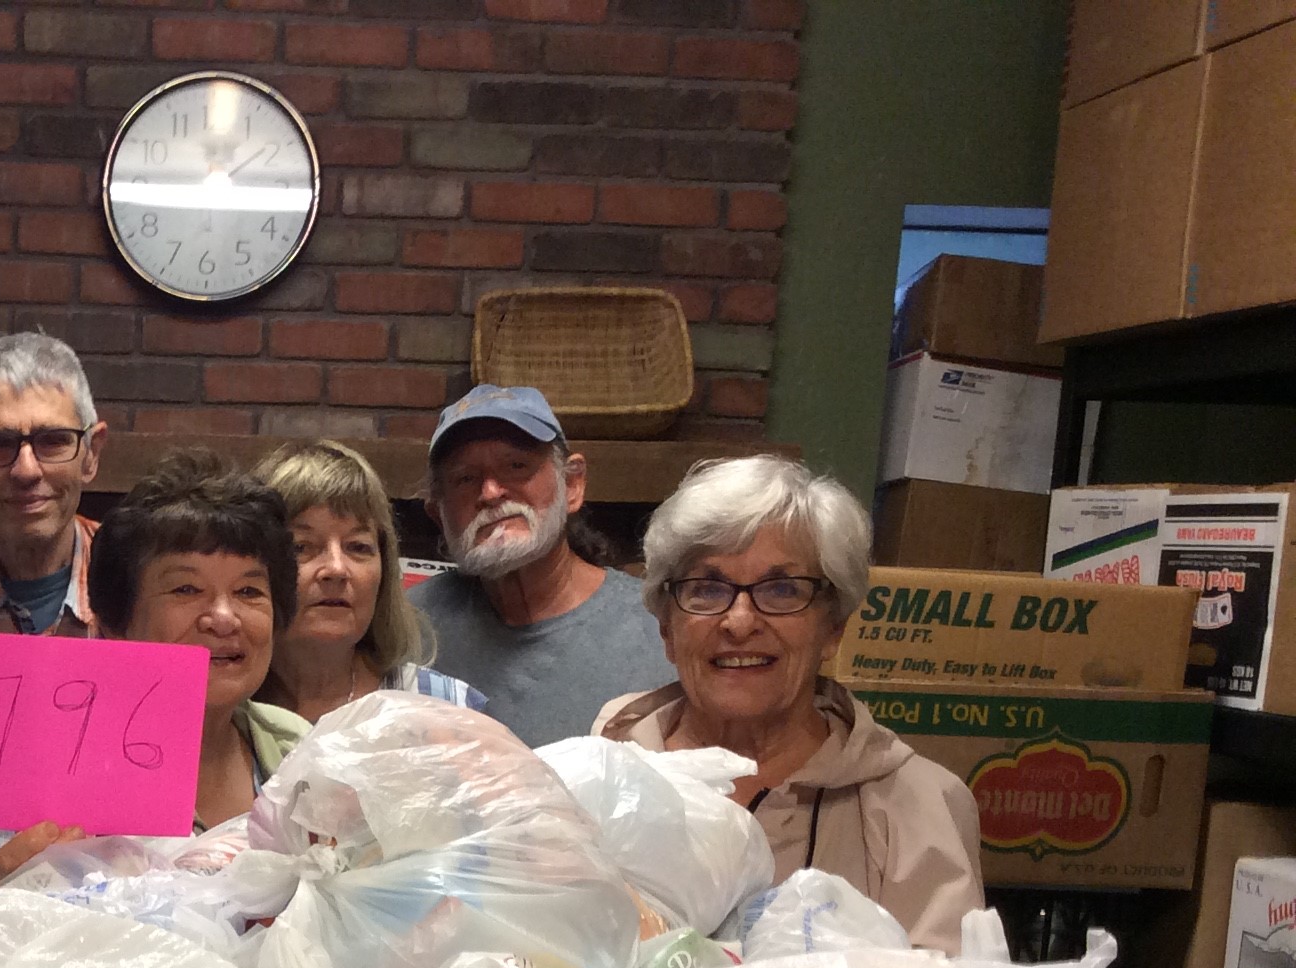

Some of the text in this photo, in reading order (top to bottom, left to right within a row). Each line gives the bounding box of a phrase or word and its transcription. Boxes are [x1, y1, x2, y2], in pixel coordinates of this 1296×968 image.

[171, 112, 188, 138] 11
[140, 212, 159, 238] 8
[260, 215, 277, 241] 4
[166, 240, 182, 266] 7
[198, 250, 216, 275] 6
[234, 240, 252, 266] 5
[1207, 567, 1246, 592] Royal
[860, 585, 1098, 635] SMALL BOX
[857, 626, 933, 643] 1.5 CU FT.
[852, 654, 897, 673] Heavy
[943, 660, 977, 678] Easy
[982, 662, 997, 676] to
[1000, 663, 1025, 678] Lift
[1029, 664, 1057, 680] Box
[1000, 703, 1044, 728] U.S.
[978, 788, 1113, 821] Del Monte
